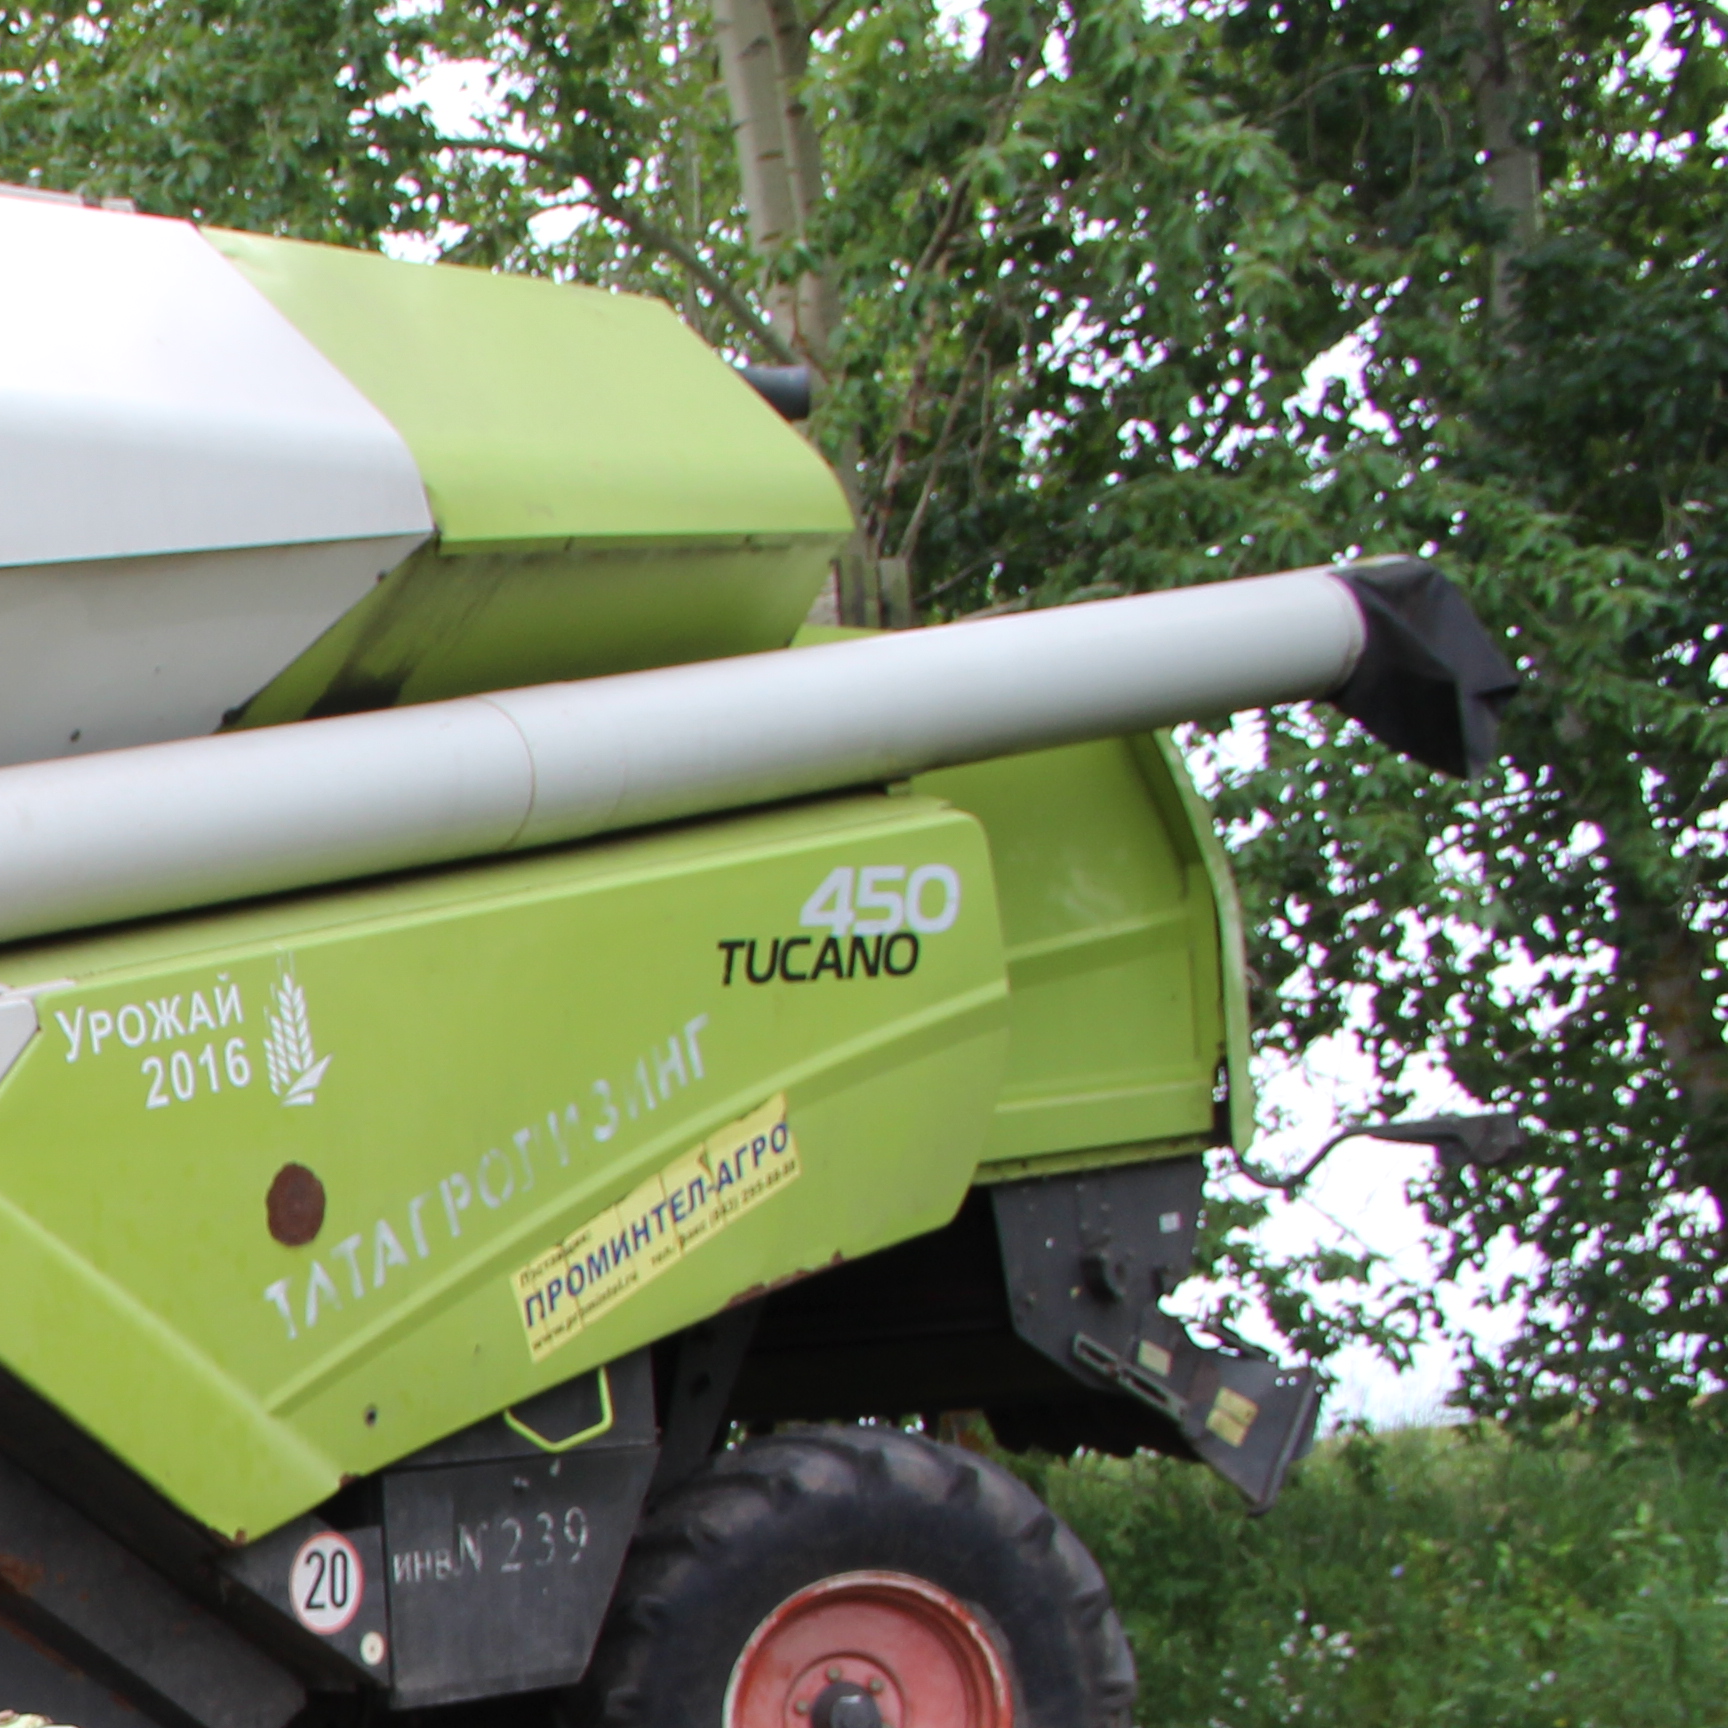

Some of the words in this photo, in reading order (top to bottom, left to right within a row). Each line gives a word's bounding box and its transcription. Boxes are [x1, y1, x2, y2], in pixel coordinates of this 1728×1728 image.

[798, 863, 961, 936] 450
[717, 932, 921, 987] TUCANO
[54, 973, 244, 1064] УРОЖАЙ
[141, 1037, 252, 1110] 2016
[524, 1121, 790, 1329] ПРОМИНТЕЛ-АГРО
[500, 1506, 590, 1573] 239
[304, 1550, 348, 1611] 20
